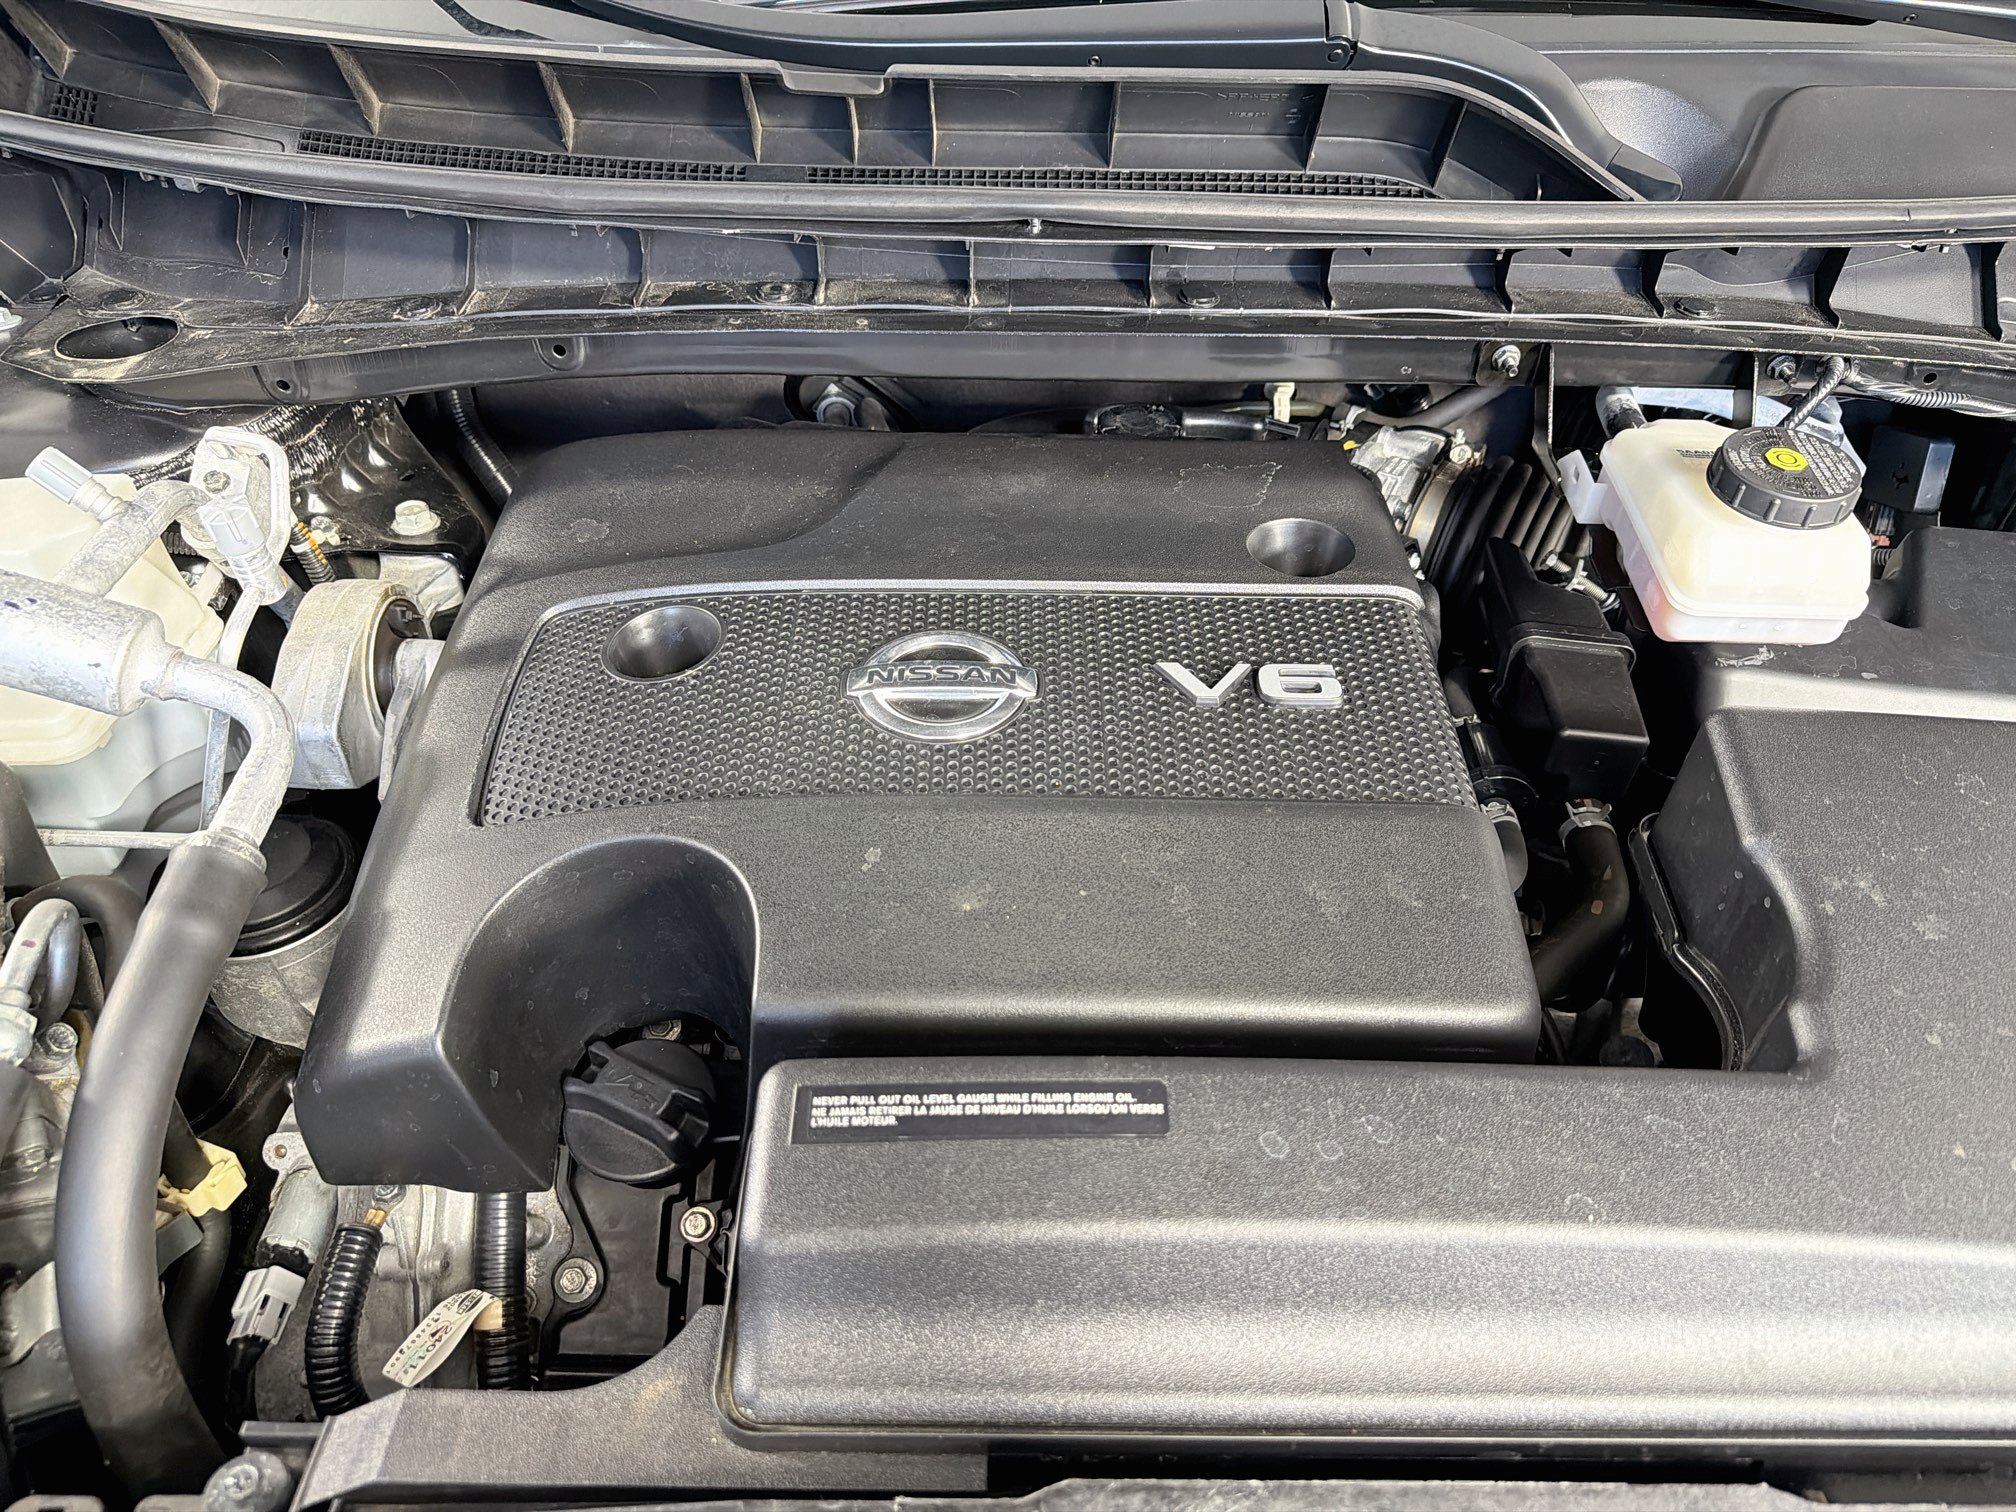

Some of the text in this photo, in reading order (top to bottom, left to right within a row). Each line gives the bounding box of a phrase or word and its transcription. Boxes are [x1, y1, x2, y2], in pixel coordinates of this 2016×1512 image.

[867, 667, 1017, 686] NISSAN
[1153, 663, 1344, 708] V6
[812, 1092, 1138, 1106] NEVER PULL OUT OIL LEVEL GAUGE WHILE FILLING ENGINE OIL.
[811, 1103, 1165, 1117] NE JAMAIS RETIRER LA JAUGE DE NIVEAU D'HUILE LORSQU'ON VERSE
[810, 1115, 898, 1128] L'HUILE MOTEUR.
